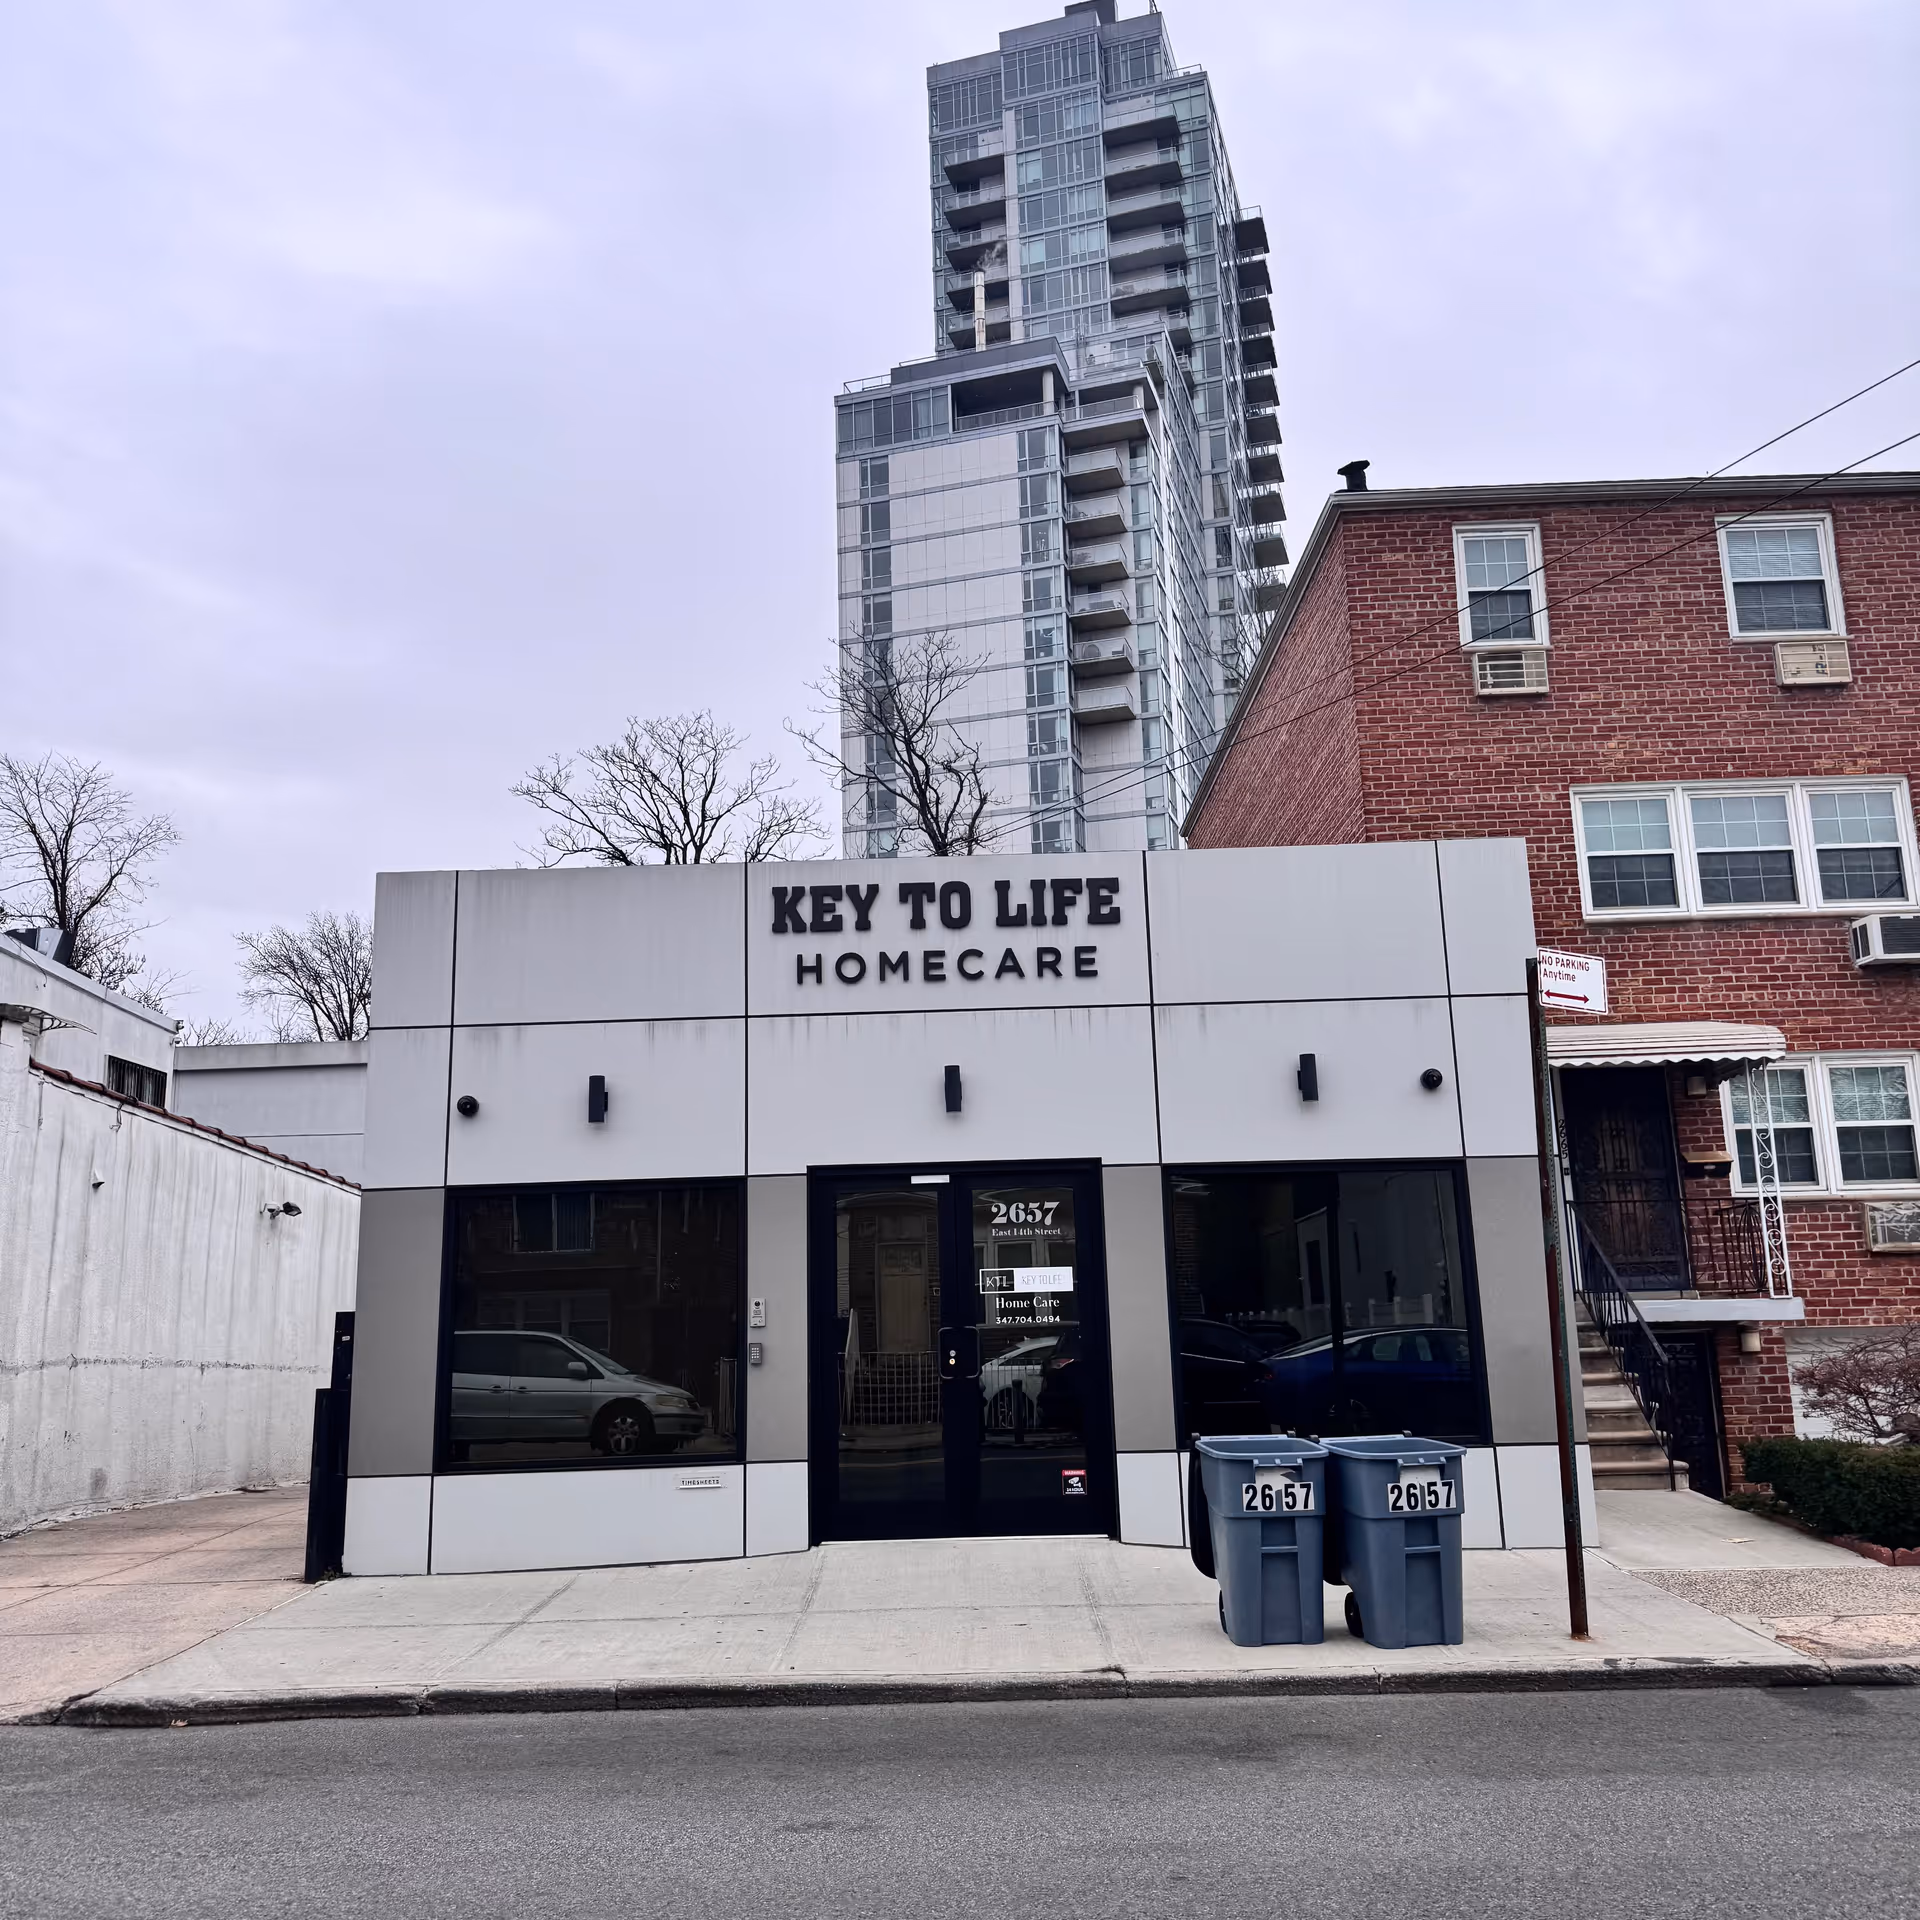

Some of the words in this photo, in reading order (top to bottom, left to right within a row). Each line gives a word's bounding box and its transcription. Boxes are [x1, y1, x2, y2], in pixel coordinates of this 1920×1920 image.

[772, 884, 880, 933] KEY
[899, 880, 972, 929] TO
[994, 877, 1121, 927] LIFE
[796, 945, 1099, 985] HOMECARE
[1541, 955, 1553, 966] NO
[1555, 957, 1589, 971] PARKING
[1543, 968, 1576, 982] Anytime
[991, 1201, 1060, 1226] 2657
[991, 1228, 1012, 1237] East
[1013, 1228, 1033, 1236] 14th
[1034, 1227, 1061, 1236] Street
[986, 1275, 1010, 1288] KTL
[995, 1297, 1030, 1309] Home
[1033, 1296, 1060, 1308] Care
[995, 1315, 1061, 1325] 347.704.0494
